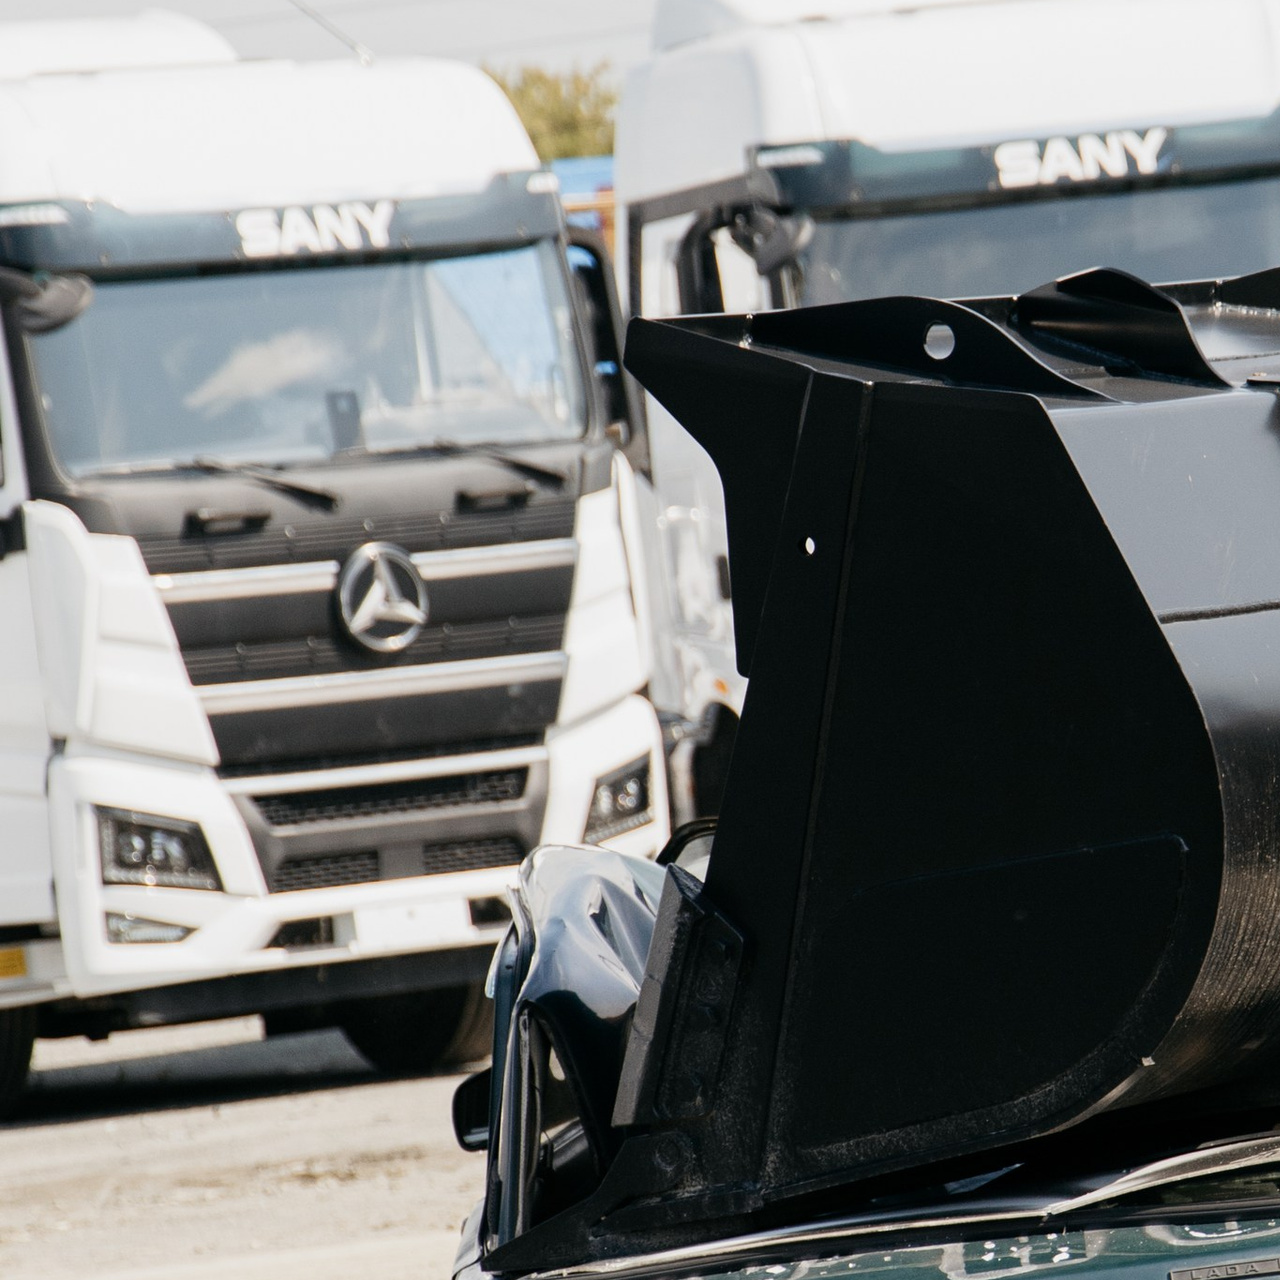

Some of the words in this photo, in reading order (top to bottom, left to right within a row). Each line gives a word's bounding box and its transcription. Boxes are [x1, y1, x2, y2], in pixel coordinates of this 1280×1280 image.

[994, 126, 1167, 188] SANY
[235, 199, 394, 258] SANY
[1190, 1264, 1260, 1280] LADA
